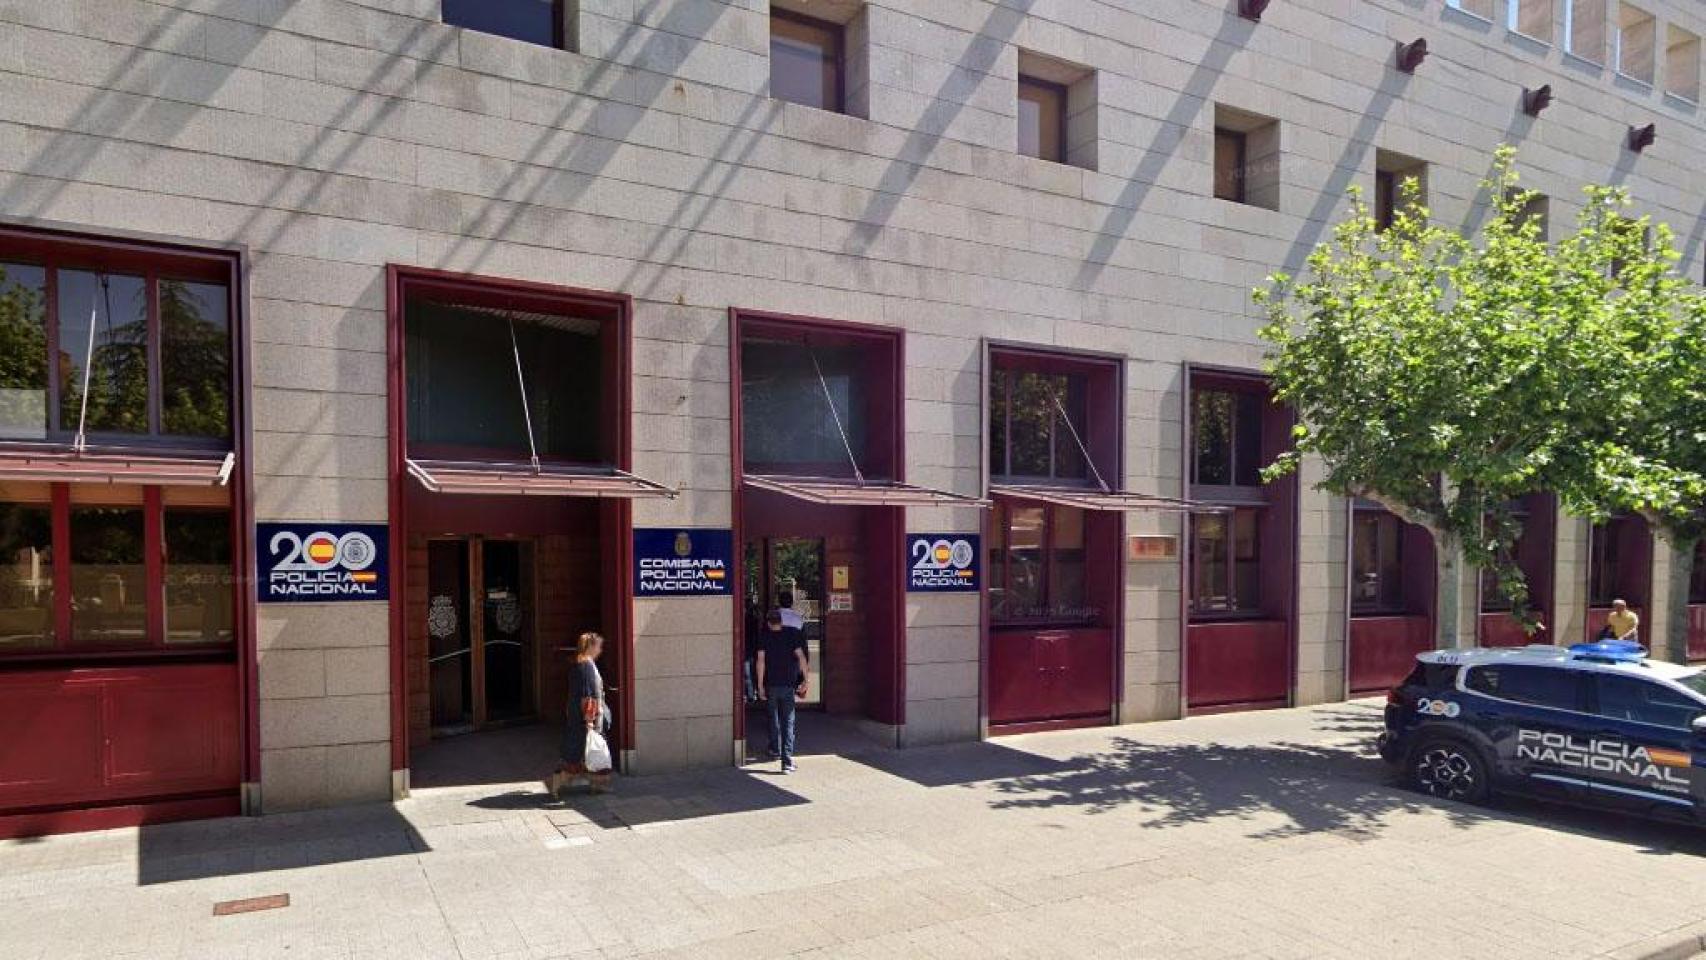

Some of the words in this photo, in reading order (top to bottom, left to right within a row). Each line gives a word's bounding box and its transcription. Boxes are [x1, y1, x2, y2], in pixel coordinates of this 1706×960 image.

[270, 531, 376, 570] 200
[913, 539, 973, 569] 200
[640, 558, 725, 568] COMISARIA
[270, 572, 355, 583] POLICIA
[641, 570, 707, 579] POLICIA
[913, 569, 961, 577] POLICIA
[641, 581, 724, 591] NACIONAL
[913, 578, 973, 586] NACIONAL
[270, 584, 377, 594] NACIONAL
[1417, 698, 1460, 717] 200
[1518, 729, 1652, 762] POLICIA
[1517, 744, 1690, 784] NACIONAL
